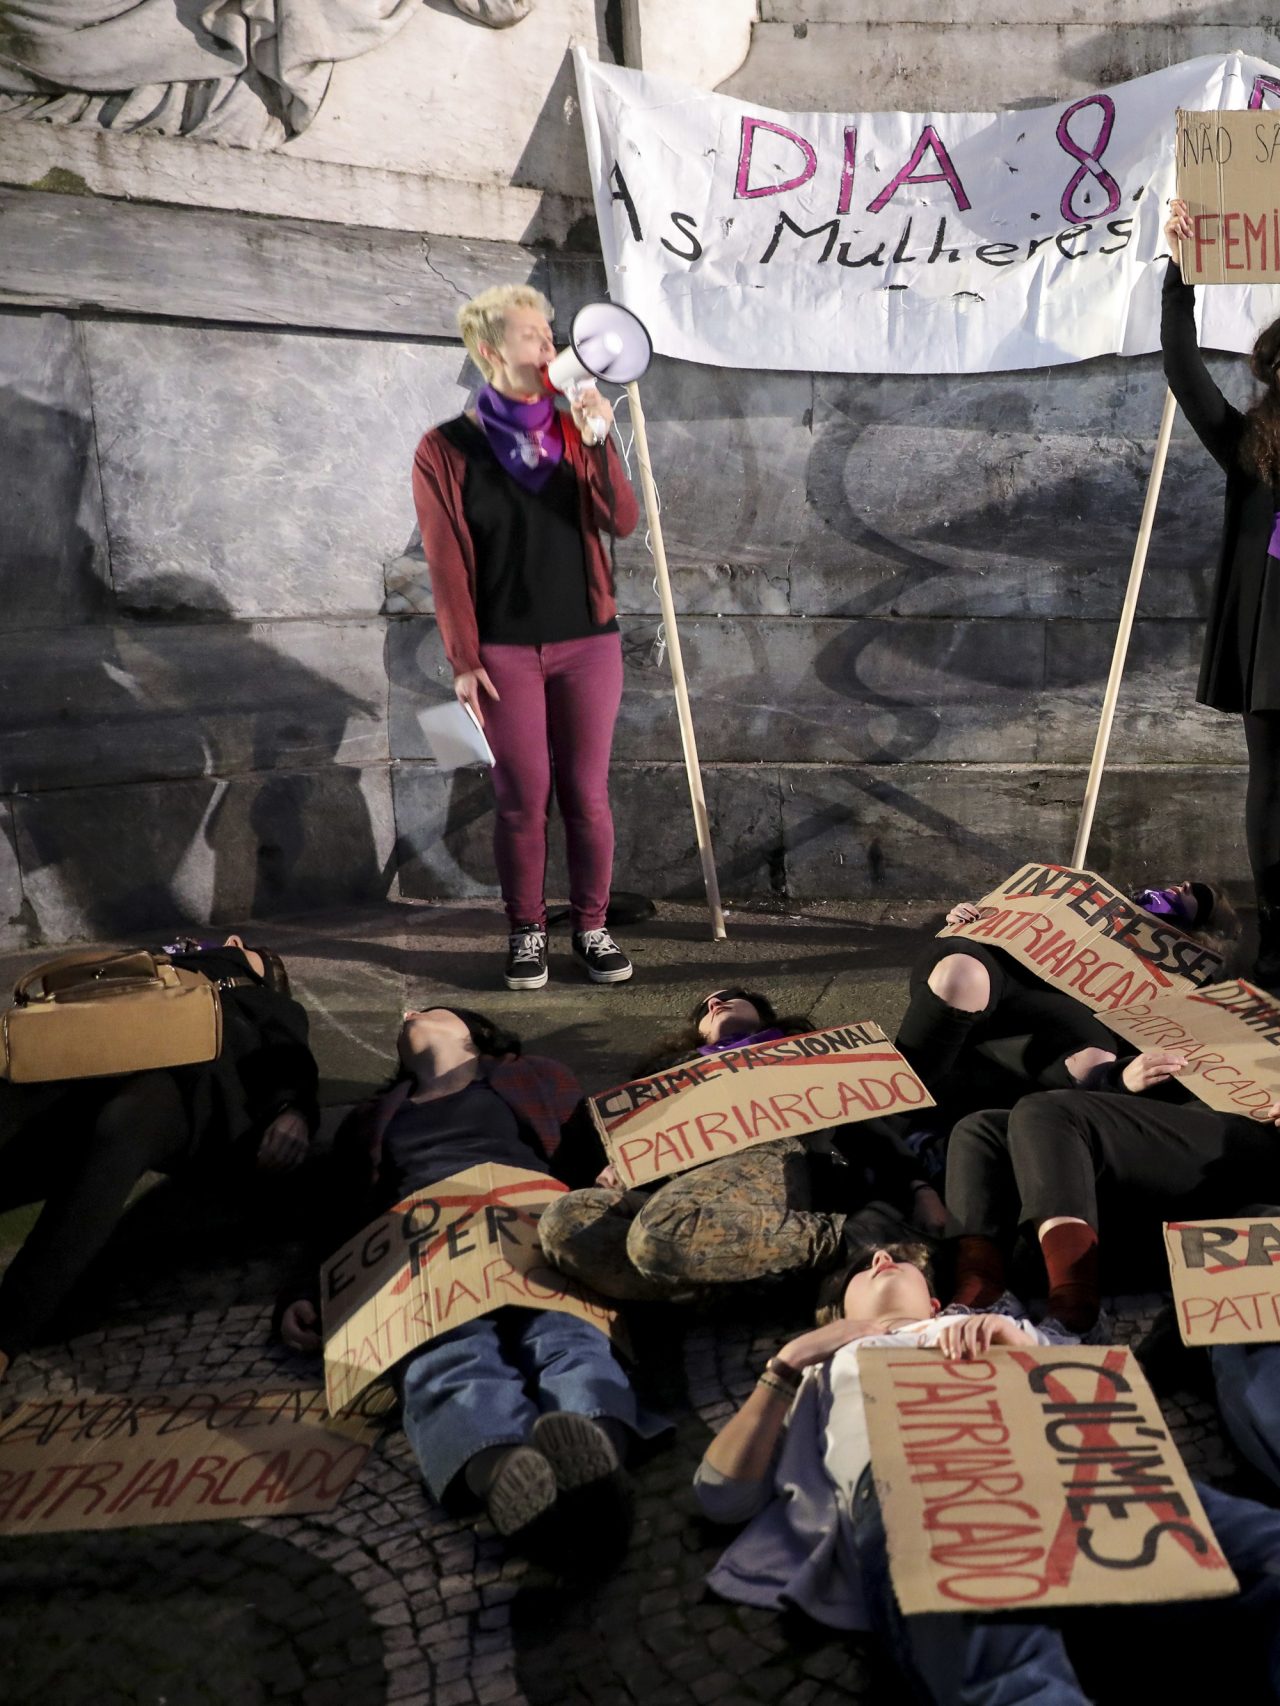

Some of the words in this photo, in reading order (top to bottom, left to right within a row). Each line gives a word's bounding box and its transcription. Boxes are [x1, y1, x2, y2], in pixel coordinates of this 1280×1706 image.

[734, 115, 972, 214] DIA
[1055, 94, 1122, 223] 8
[1183, 122, 1232, 167] NÃO
[759, 210, 1136, 268] Mulheres
[951, 906, 1160, 1010] PATRIARCAD
[1003, 867, 1224, 988] INTERESSE
[600, 1059, 722, 1118] CRIME
[717, 1024, 887, 1073] PASSIONAL
[618, 1072, 926, 1182] PATRIARCADO
[328, 1199, 441, 1300] EGO
[887, 1359, 1049, 1606] PATRIARCADO
[1028, 1361, 1208, 1570] CIÚMES
